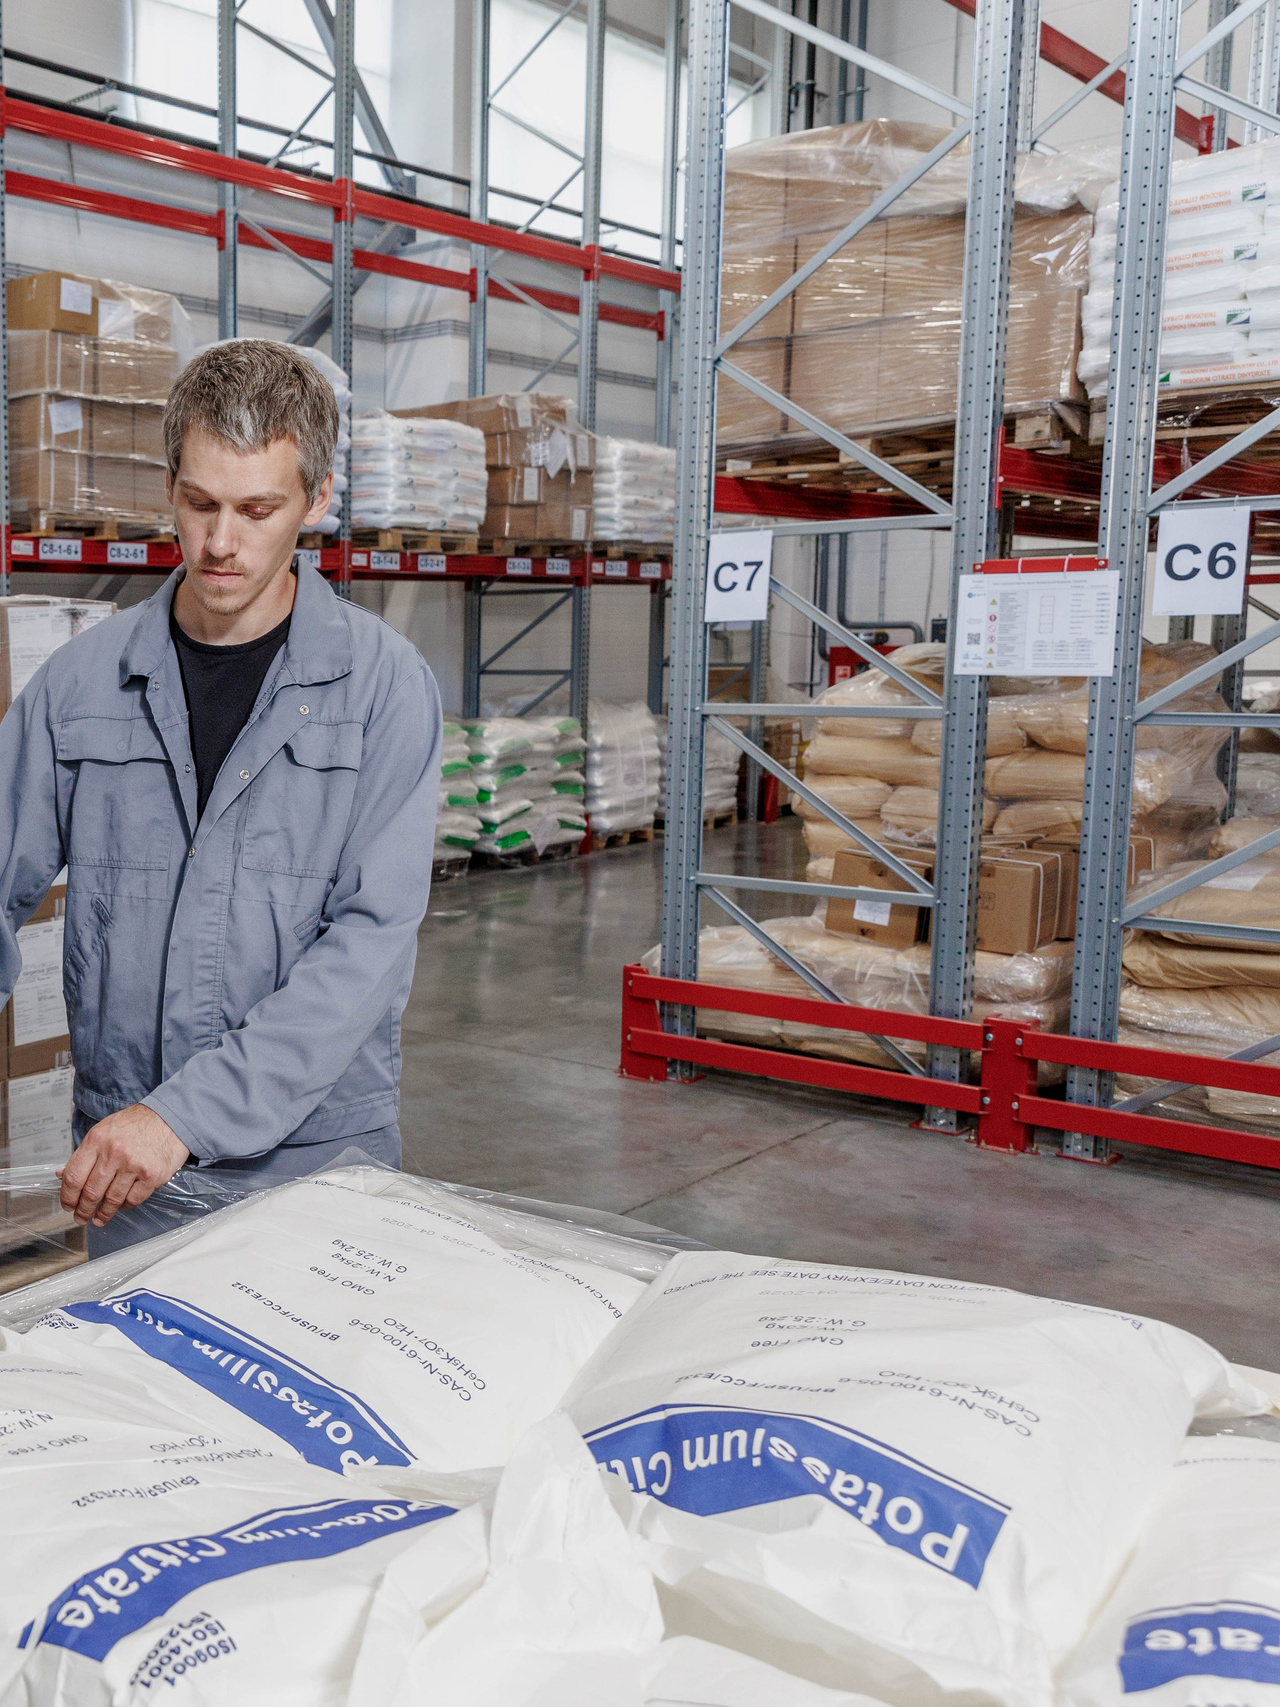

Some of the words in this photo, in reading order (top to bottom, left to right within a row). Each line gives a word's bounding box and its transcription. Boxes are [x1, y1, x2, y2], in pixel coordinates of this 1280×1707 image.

[1199, 190, 1231, 200] TRISODIUM
[1180, 375, 1210, 385] TRISODIUM
[1211, 373, 1236, 382] CITRATE
[1238, 369, 1271, 379] DIHYDRATE
[1164, 541, 1238, 581] C6
[713, 560, 764, 592] C7
[309, 1265, 340, 1283] Free
[663, 1275, 715, 1296] PRINTED
[719, 1270, 745, 1281] THE
[341, 1280, 376, 1296] GMO
[231, 1281, 341, 1342] BP/USP/FCC/E332
[585, 1289, 623, 1319] BATCH
[8, 1443, 48, 1456] Free
[49, 1434, 88, 1448] GMO
[682, 1427, 971, 1573] Potassium
[56, 1533, 227, 1628] Citrate
[139, 1619, 227, 1689] ISO14001
[165, 1635, 238, 1688] ISO9001
